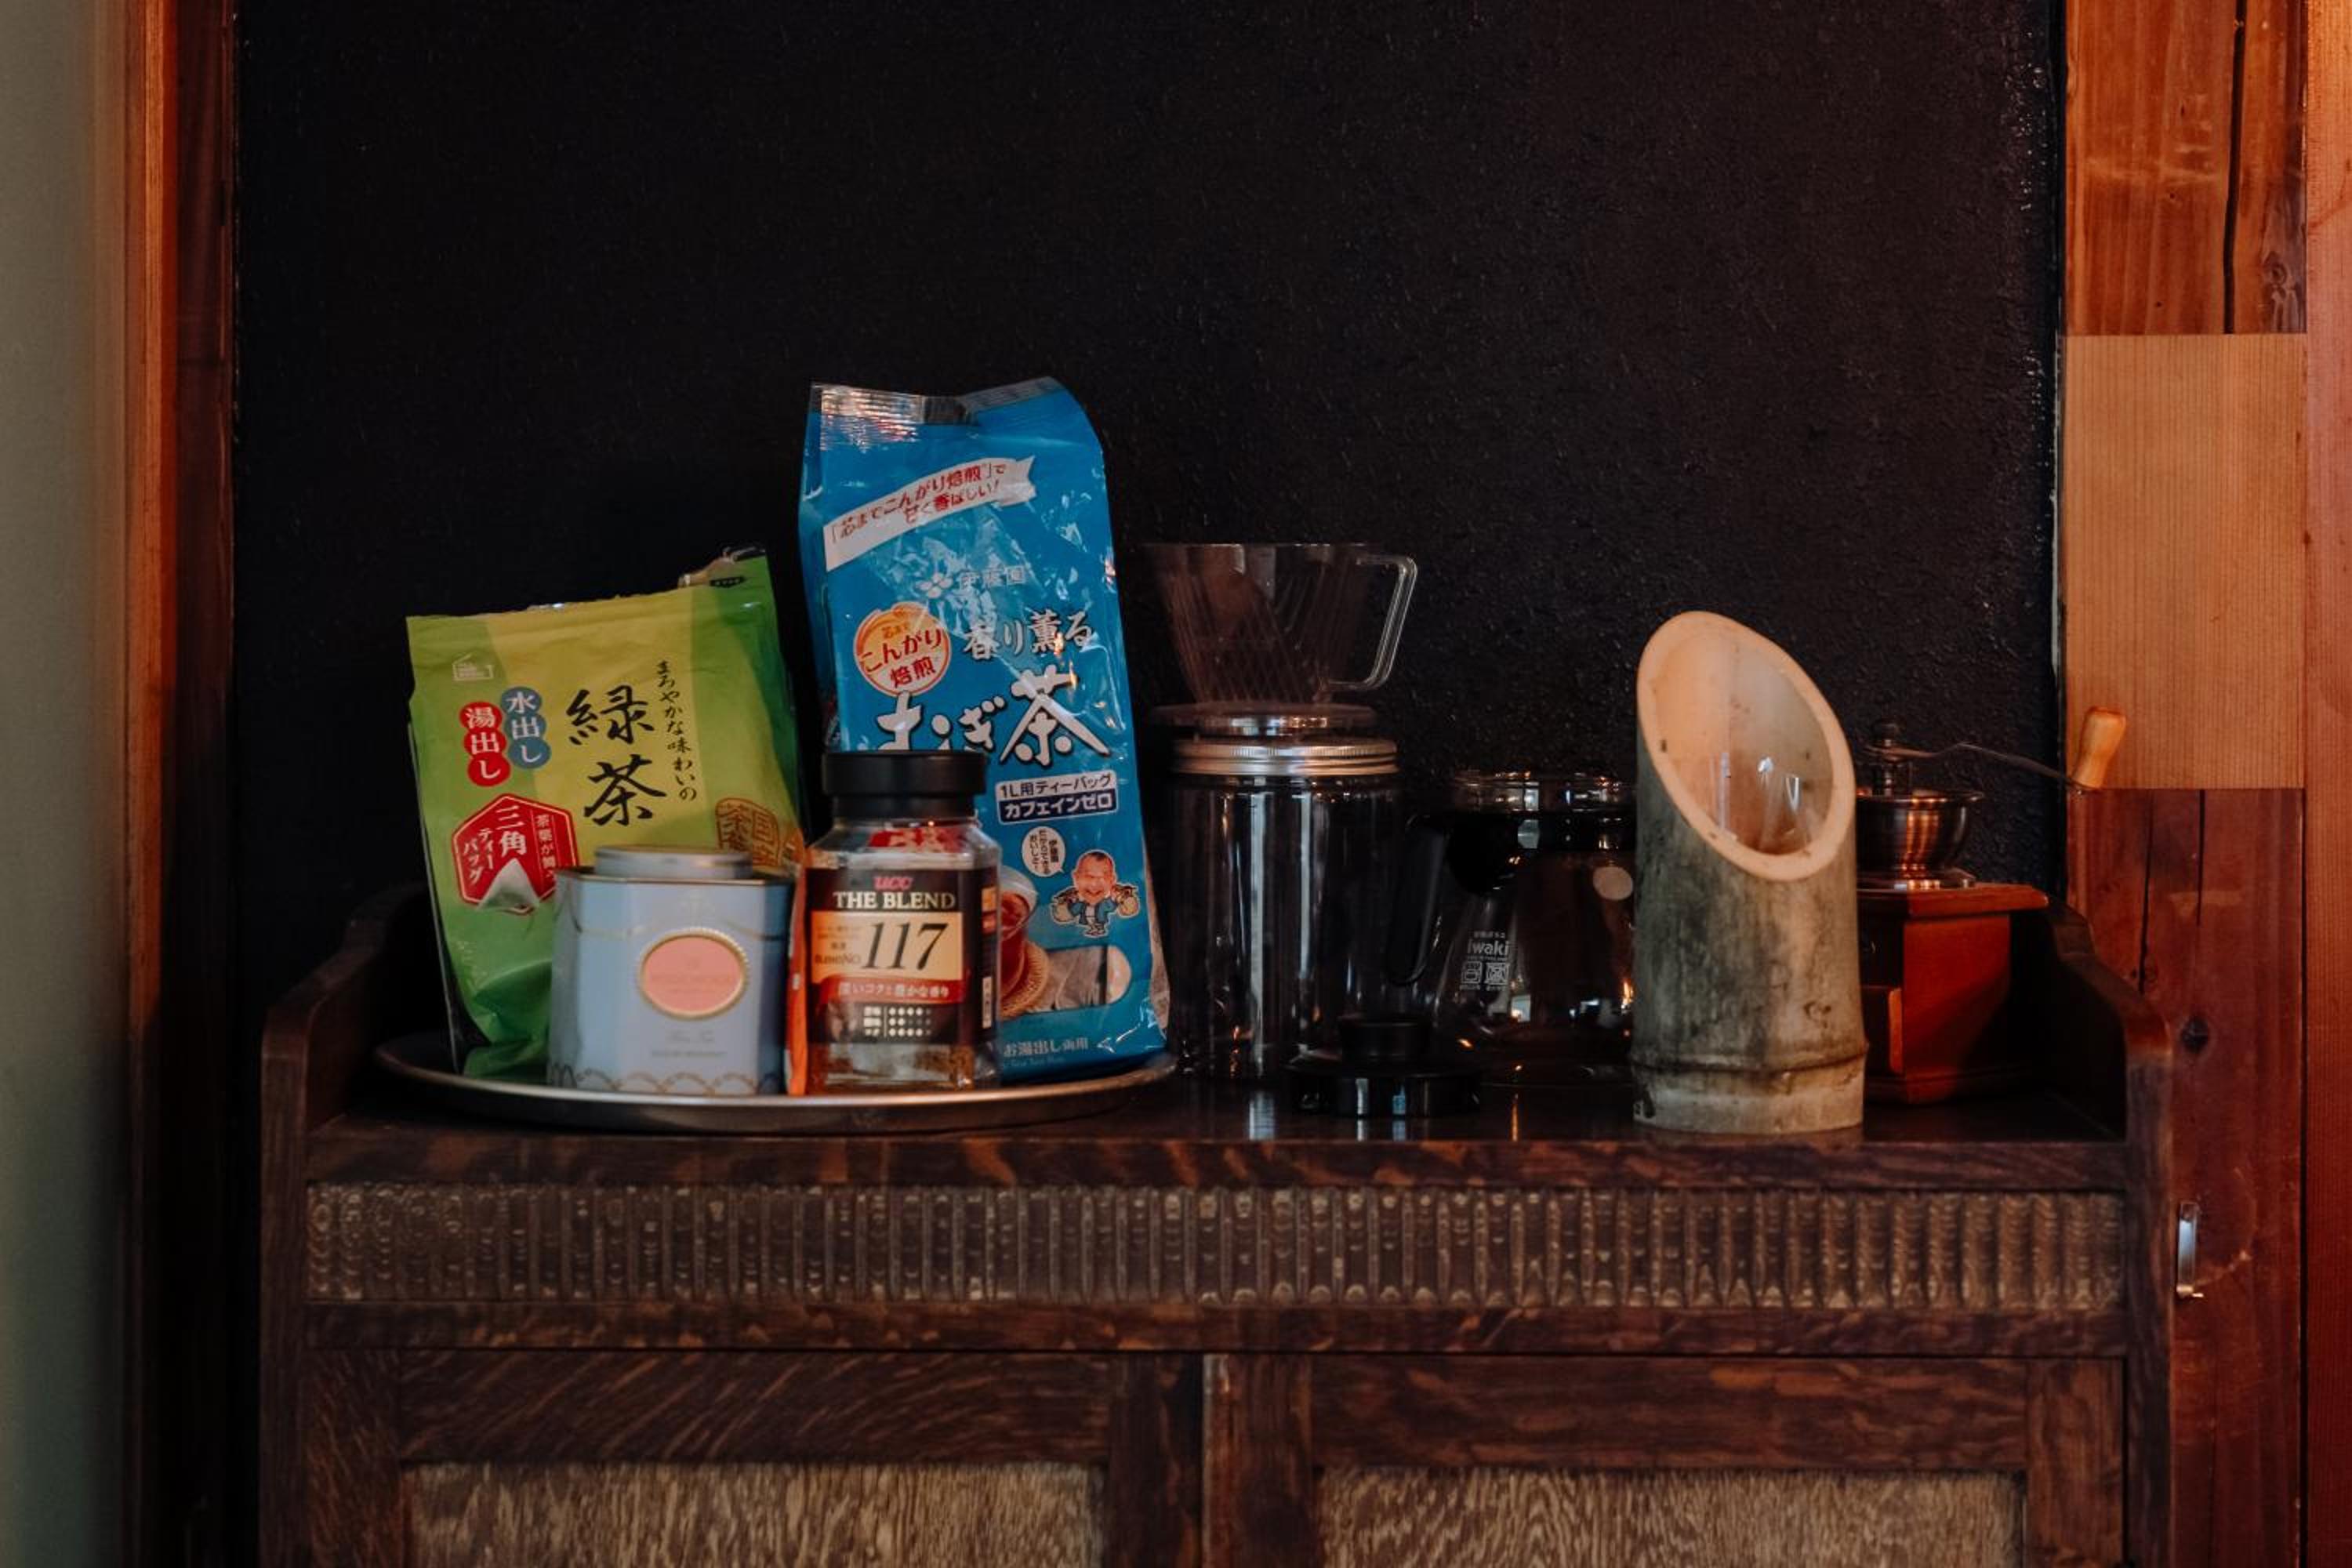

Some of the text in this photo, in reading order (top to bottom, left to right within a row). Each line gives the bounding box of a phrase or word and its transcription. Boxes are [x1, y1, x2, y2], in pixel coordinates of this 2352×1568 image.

[861, 629, 942, 673] こんがり
[963, 610, 1093, 660] 香り薫る
[891, 657, 935, 688] 焙煎
[465, 706, 502, 779] 湯出し
[504, 691, 542, 763] 水出し
[565, 684, 667, 827] 緑茶
[1000, 773, 1112, 799] 1L用ティーバッグ
[1004, 793, 1113, 818] カフェインゼロ
[495, 805, 527, 858] 三角
[833, 891, 956, 909] THE BLEND
[862, 920, 949, 971] 117
[1468, 938, 1509, 956] iwaki
